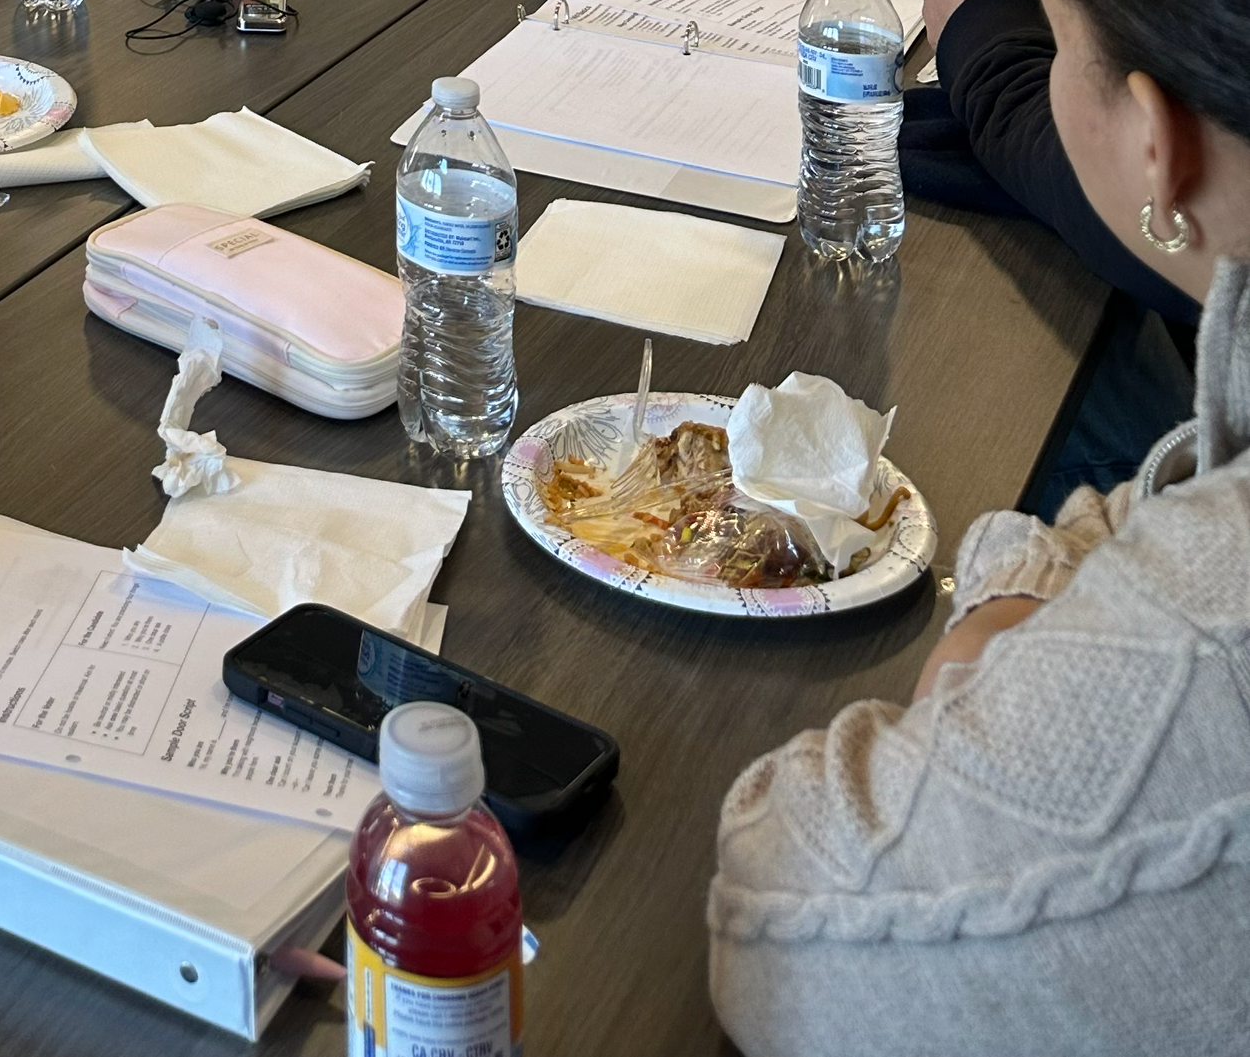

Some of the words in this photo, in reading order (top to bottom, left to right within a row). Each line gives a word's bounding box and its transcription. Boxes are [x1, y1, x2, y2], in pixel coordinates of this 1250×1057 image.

[214, 230, 260, 253] SPECIAL
[161, 738, 179, 761] Sample
[172, 720, 186, 736] Door
[180, 699, 196, 719] Script
